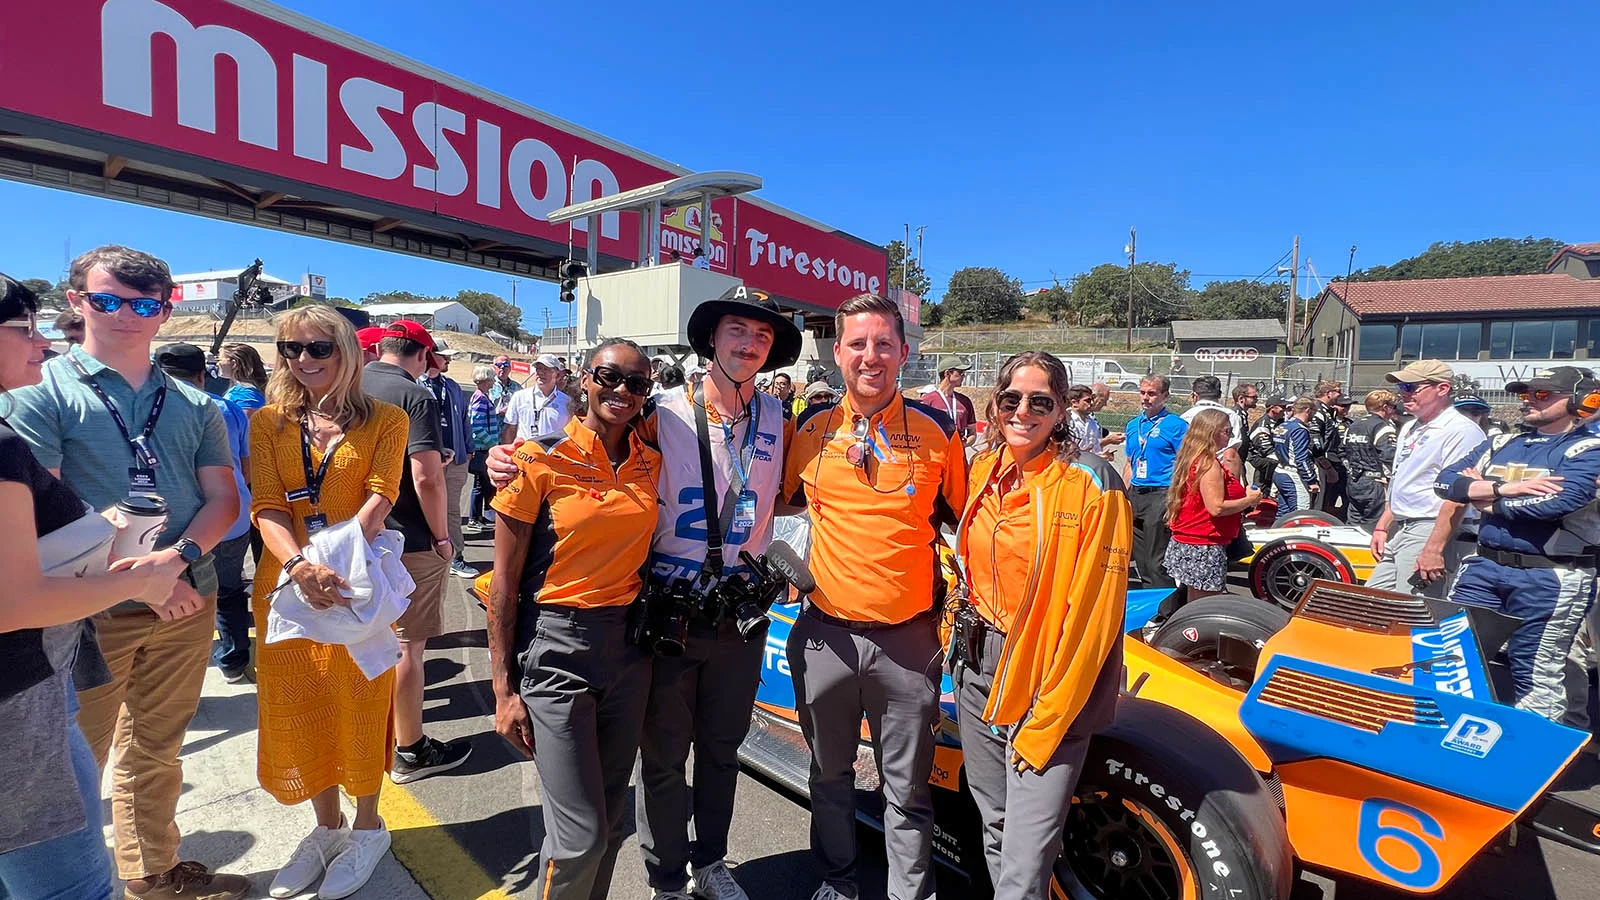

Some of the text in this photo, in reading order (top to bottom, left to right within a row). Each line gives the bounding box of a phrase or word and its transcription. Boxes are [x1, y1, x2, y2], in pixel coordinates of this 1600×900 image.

[745, 228, 880, 295] Firestone
[1451, 738, 1482, 750] AWARD
[931, 840, 961, 863] stone
[1106, 759, 1231, 877] Firestone
[1357, 797, 1446, 889] 6
